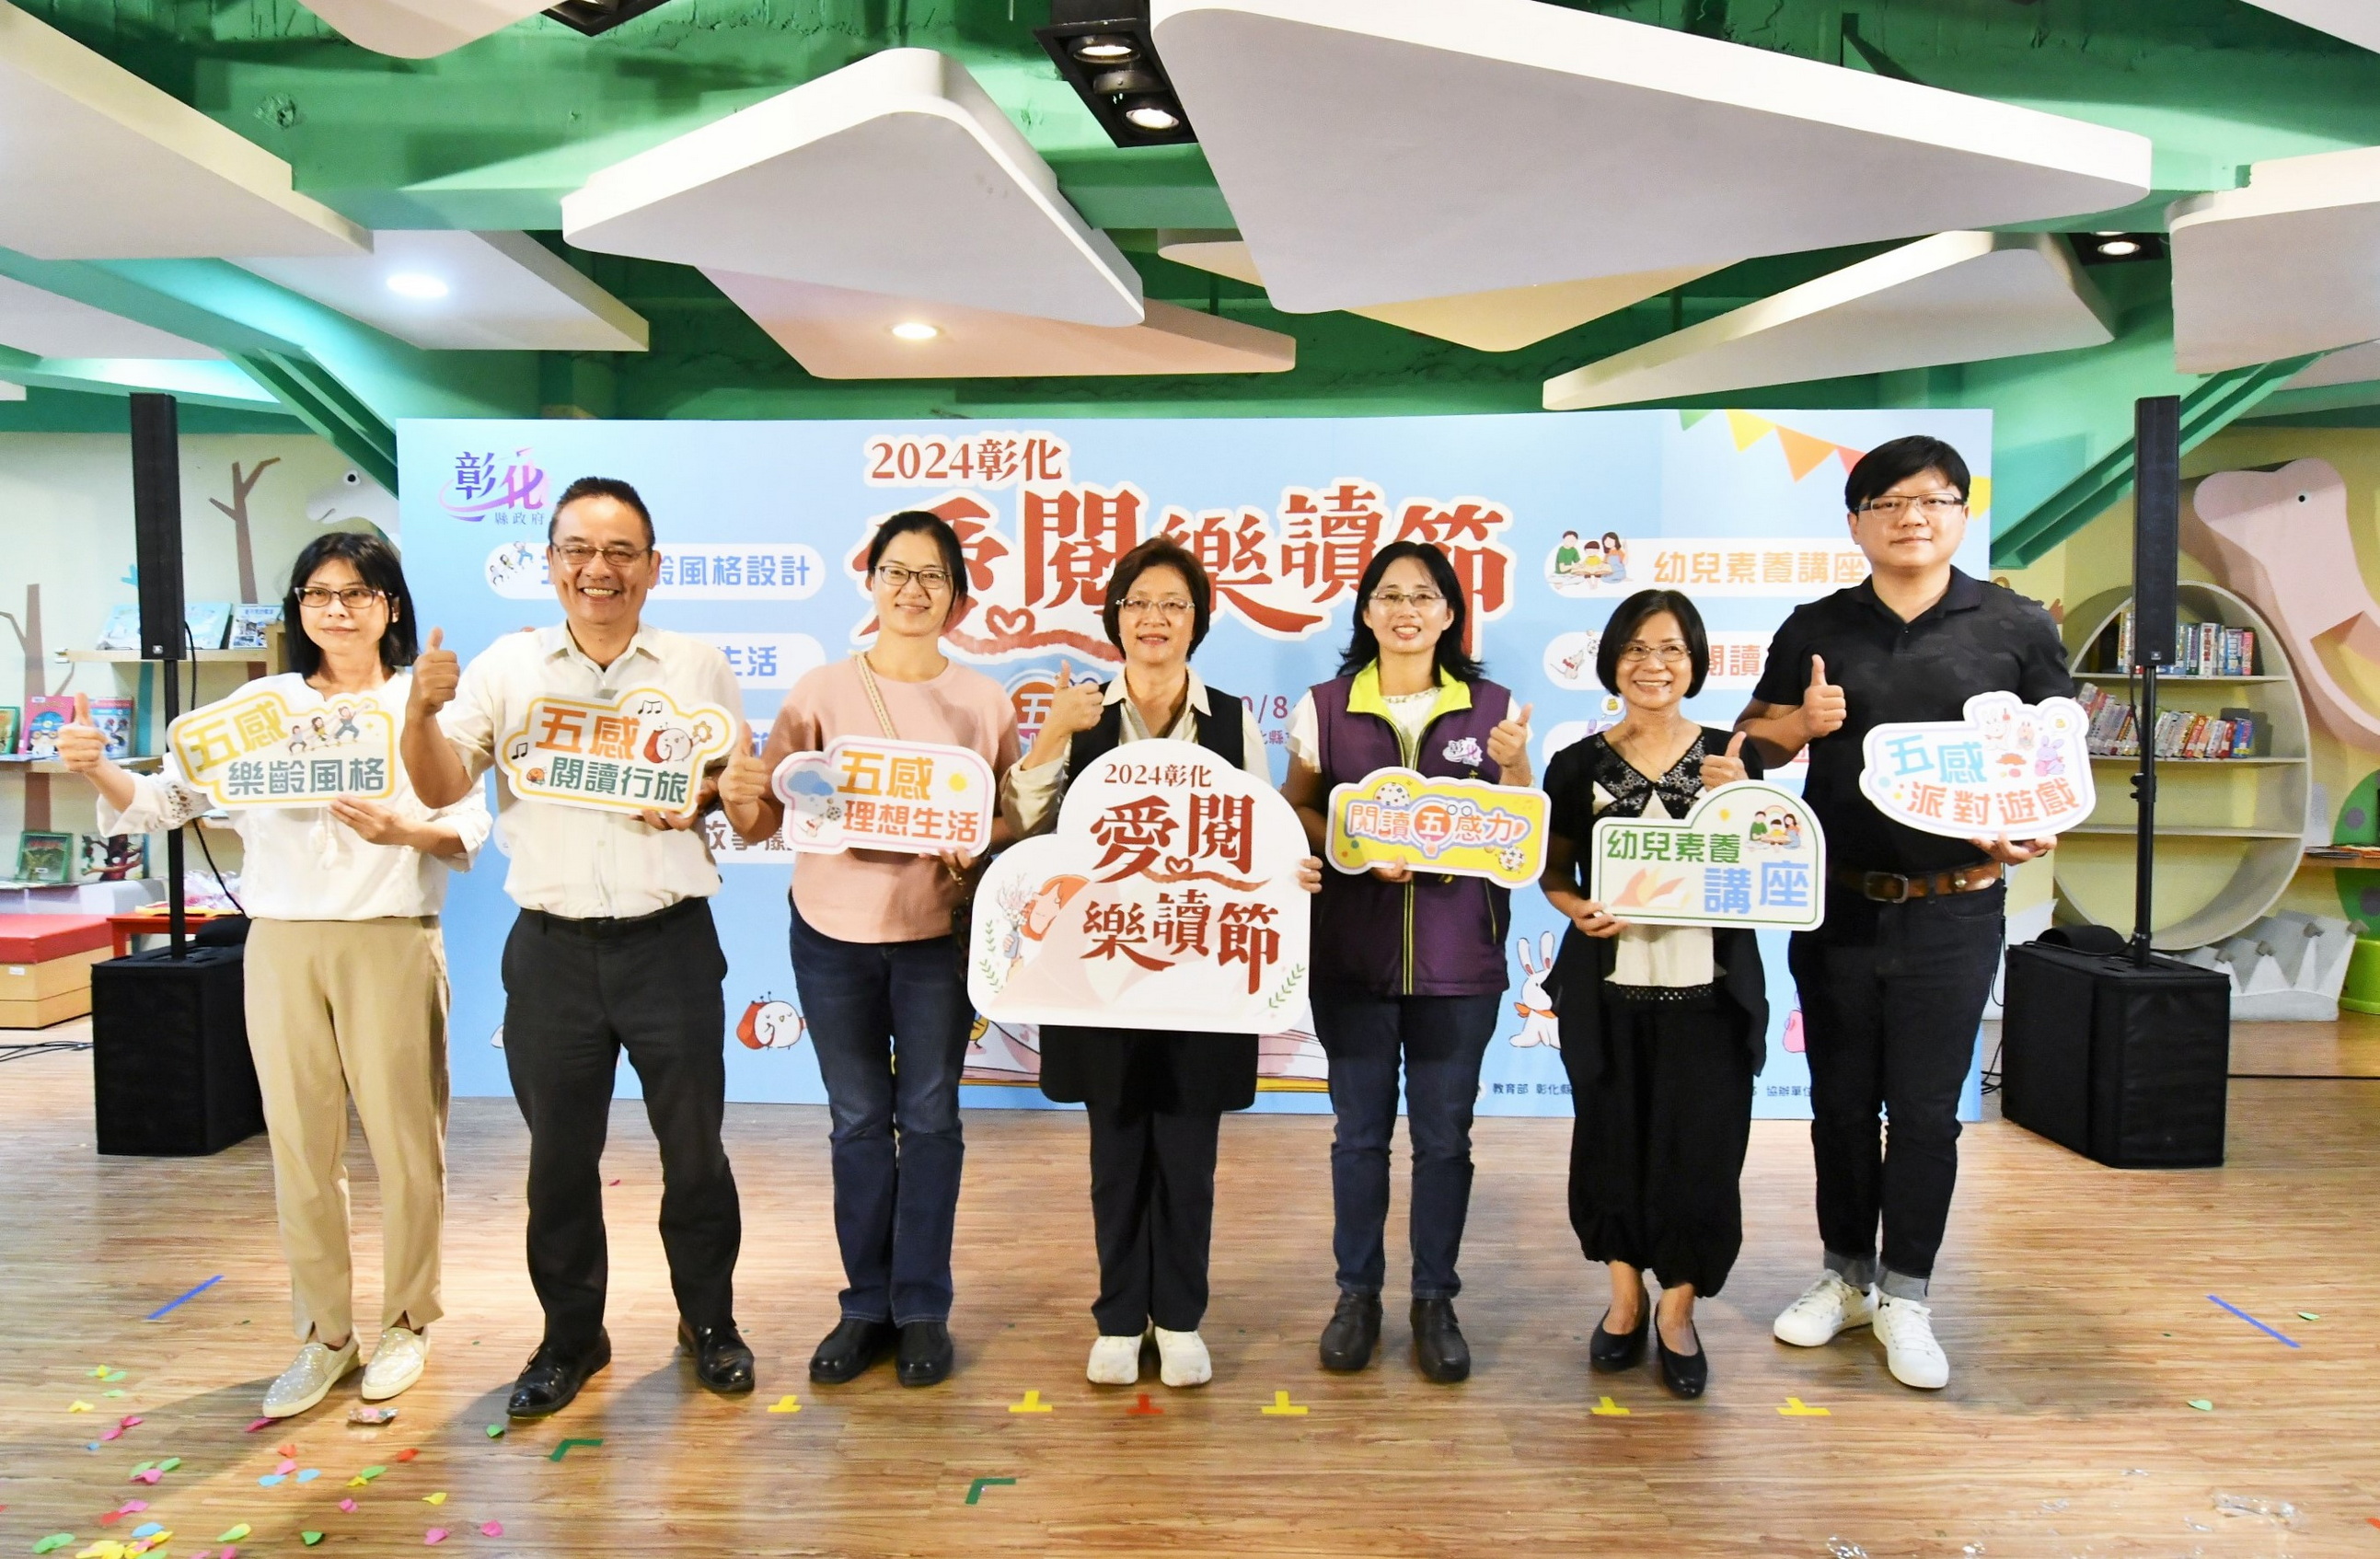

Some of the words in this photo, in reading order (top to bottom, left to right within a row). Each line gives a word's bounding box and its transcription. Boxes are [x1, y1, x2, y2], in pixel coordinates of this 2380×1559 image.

[455, 447, 545, 510] 彰化
[872, 438, 1062, 481] 2024彰化
[494, 512, 545, 525] 縣政府
[1653, 551, 1866, 583] 幼兒素養講座
[184, 700, 289, 773] 五感
[536, 706, 641, 760] 五感
[229, 757, 384, 795] 樂齡風格
[549, 756, 689, 804] 閱讀行旅
[838, 750, 935, 800] 五感
[1103, 763, 1212, 787] 2024彰化
[1885, 734, 1988, 784] 五感
[842, 800, 979, 843] 理想生活
[1906, 778, 2080, 826] 派對遊戲
[1090, 792, 1255, 883] 愛閱
[1606, 829, 1741, 863] 幼兒素養
[1704, 860, 1809, 915] 講座
[1080, 890, 1281, 995] 樂讀節
[1492, 1083, 1529, 1095] 教育部
